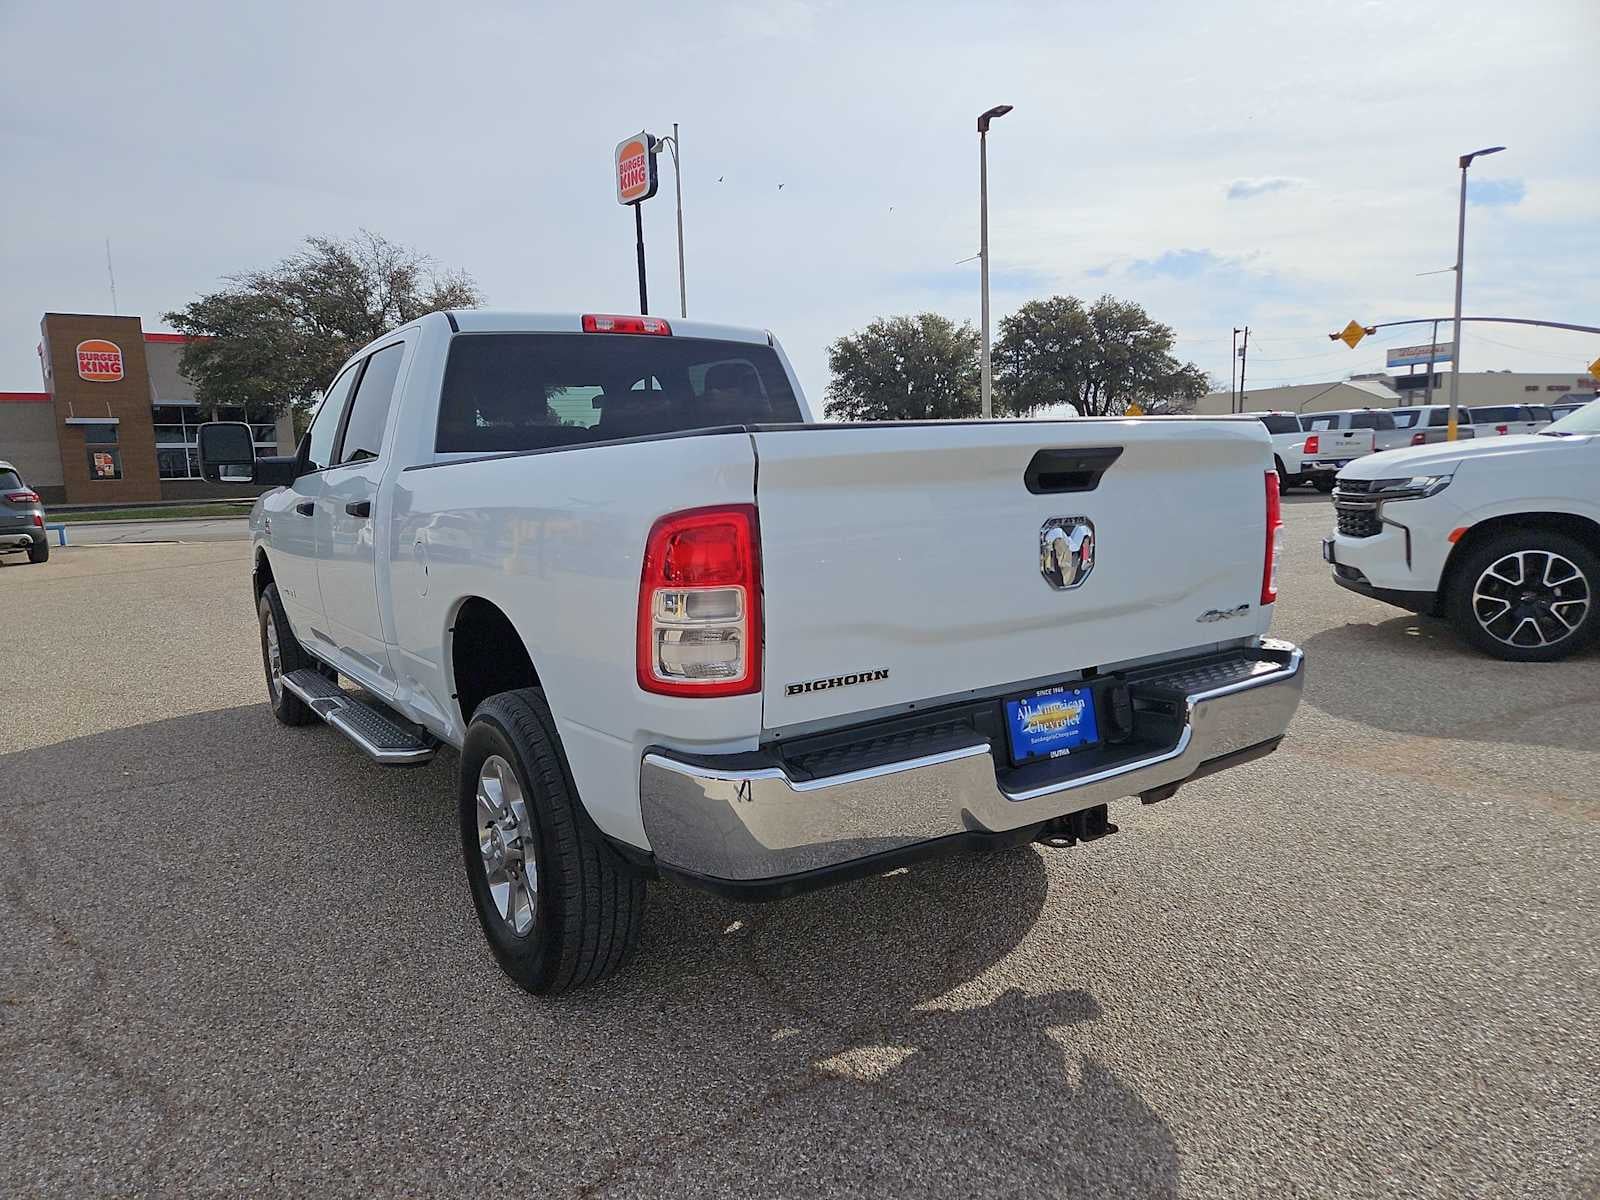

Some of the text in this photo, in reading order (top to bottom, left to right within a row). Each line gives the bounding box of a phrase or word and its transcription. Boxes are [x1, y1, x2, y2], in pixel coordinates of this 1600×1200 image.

[619, 155, 645, 175] BURGER
[620, 167, 646, 190] KING
[79, 352, 121, 361] BURGER
[80, 361, 121, 373] KING
[785, 668, 889, 697] BIGHORN
[1036, 688, 1052, 696] SINCE
[1017, 705, 1031, 720] All
[1027, 715, 1080, 734] Chevrolet
